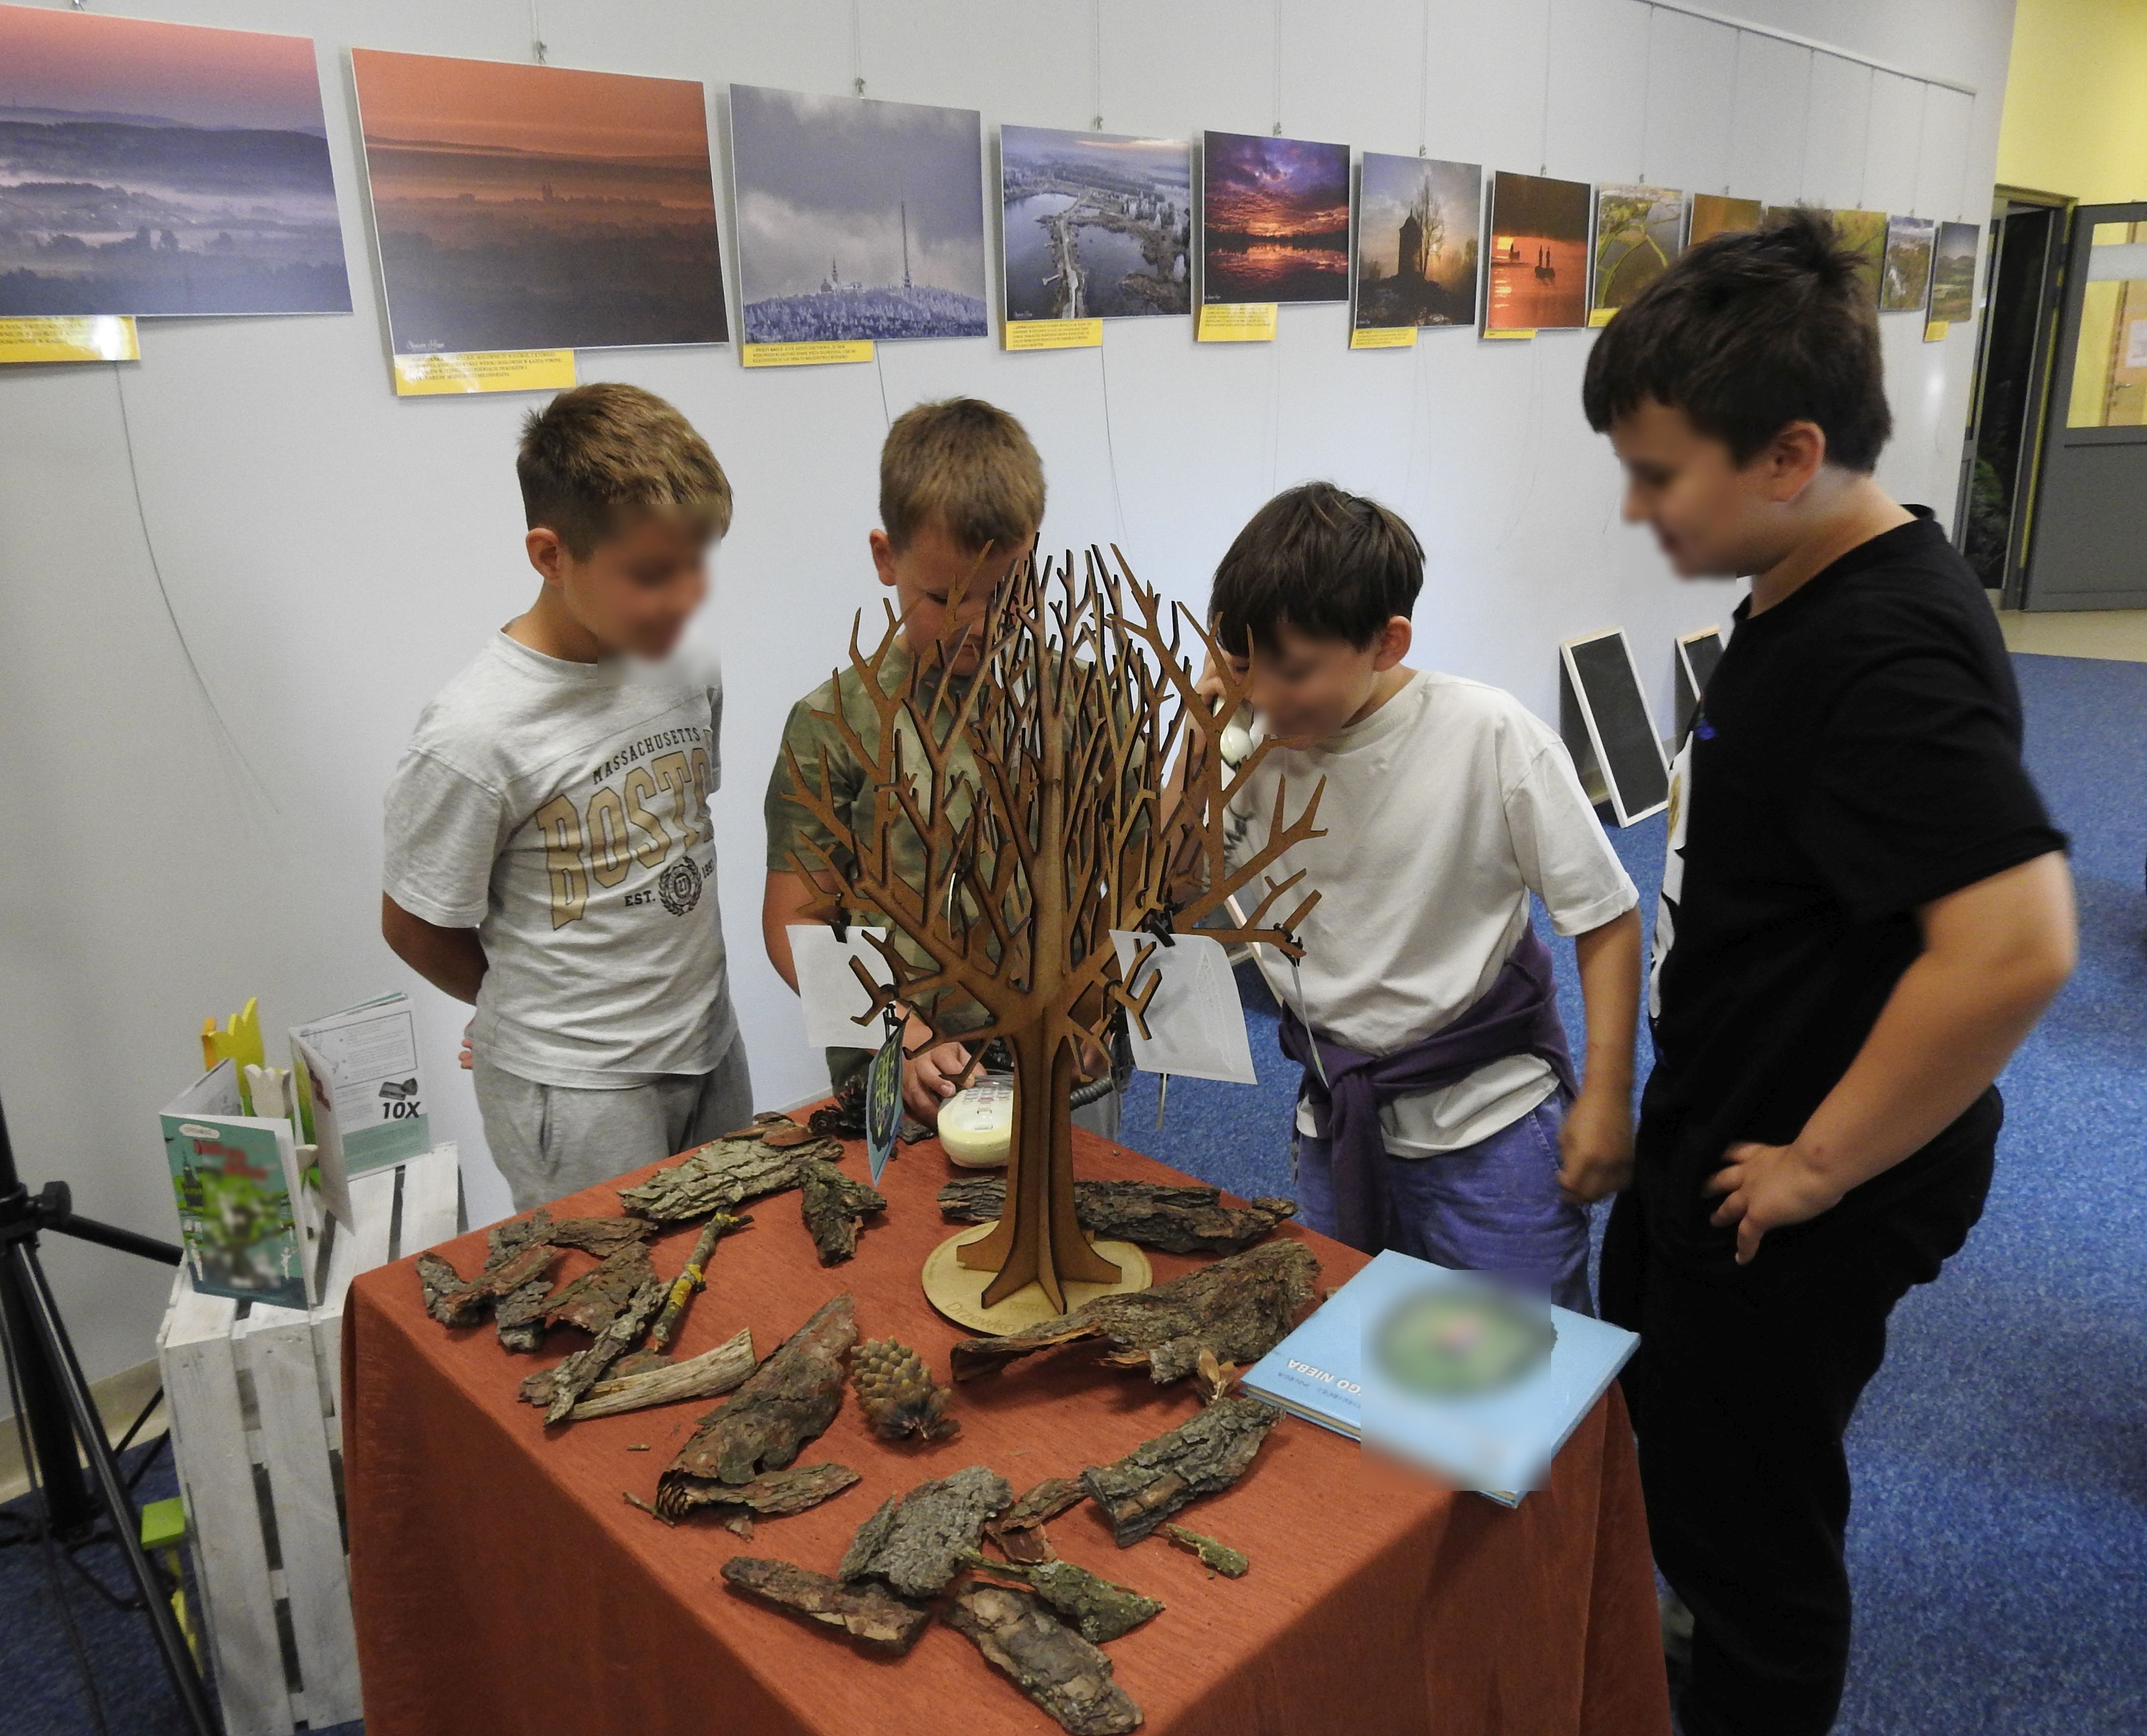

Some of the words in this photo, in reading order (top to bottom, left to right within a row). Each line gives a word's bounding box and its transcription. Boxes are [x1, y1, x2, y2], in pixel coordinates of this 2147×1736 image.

[593, 727, 701, 785] MASSACHUSETTS
[536, 741, 713, 930] BOSTO
[625, 891, 655, 906] EST.
[383, 1102, 421, 1119] 10X
[1288, 1359, 1335, 1382] NIEBA
[1337, 1379, 1361, 1396] GO
